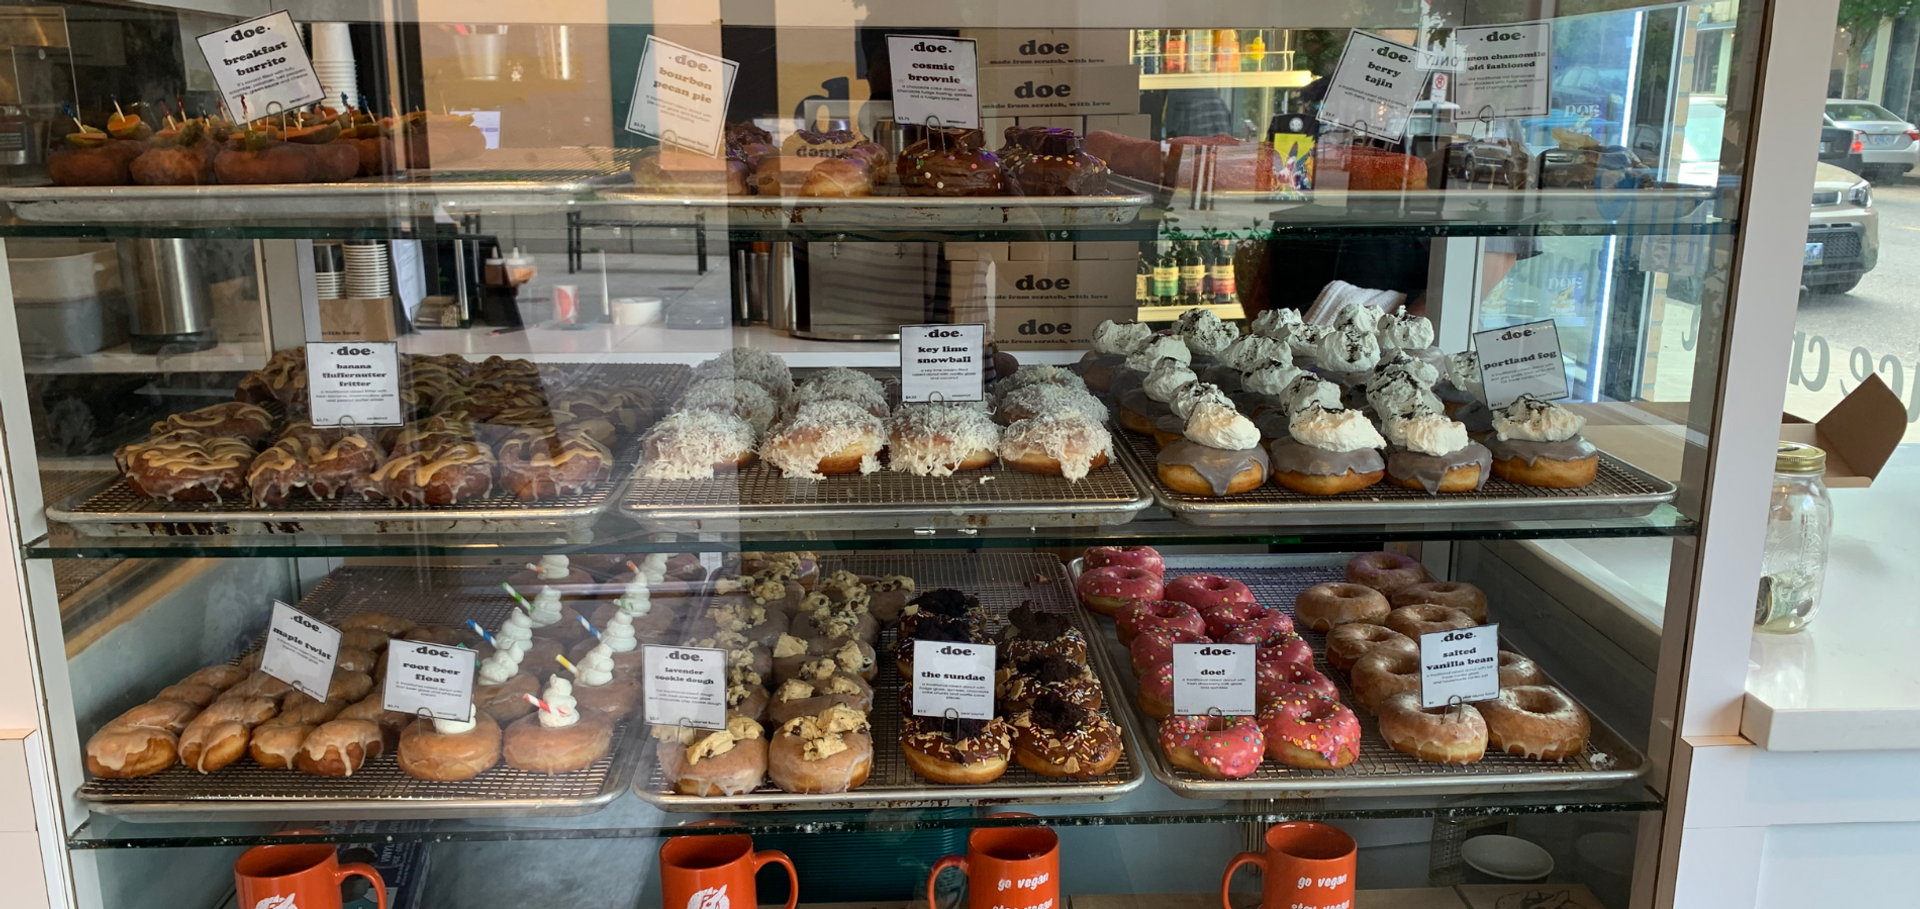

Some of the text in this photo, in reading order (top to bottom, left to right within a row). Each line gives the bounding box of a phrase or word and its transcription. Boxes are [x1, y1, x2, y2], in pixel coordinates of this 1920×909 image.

[224, 42, 288, 65] breakfast
[1019, 40, 1070, 55] doe
[1492, 51, 1546, 60] chamomile
[236, 57, 286, 76] burrito
[1368, 62, 1401, 78] berry
[1486, 62, 1535, 70] fashioned
[660, 67, 712, 90] bourbon
[908, 74, 960, 84] brownie
[1365, 75, 1392, 88] tajin
[654, 80, 712, 104] pecan pie
[1014, 82, 1071, 98] doe
[1016, 274, 1070, 290] doe
[1018, 320, 1072, 334] doe
[1483, 351, 1556, 370] portland fog
[273, 628, 303, 645] maple
[304, 642, 332, 660] twist
[1443, 647, 1476, 658] salted
[403, 662, 460, 675] root beer
[1426, 657, 1494, 671] vanilla bean
[415, 673, 446, 684] float
[943, 673, 986, 681] sundae
[997, 872, 1049, 891] go vegan
[1297, 873, 1347, 890] go vegan
